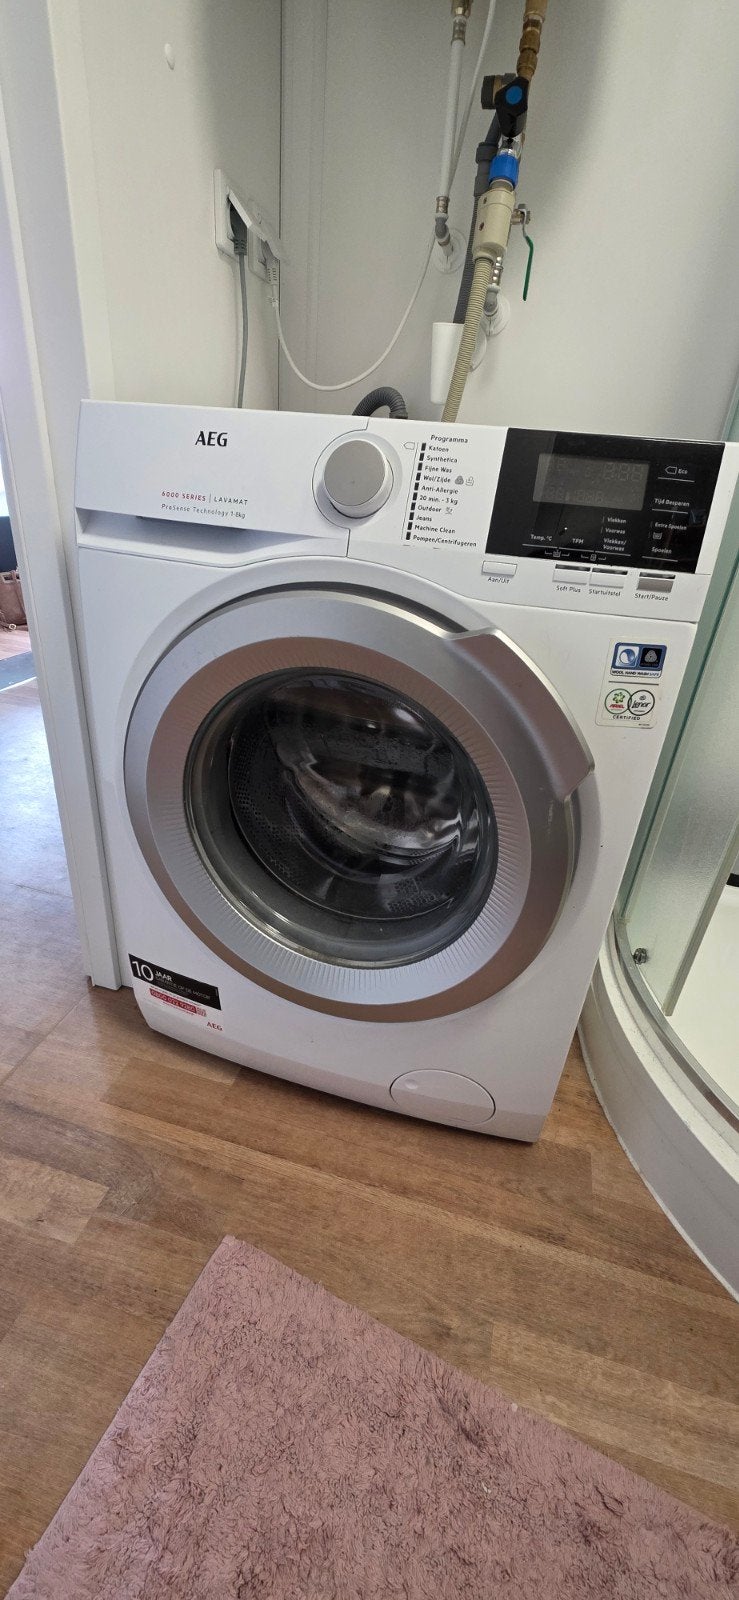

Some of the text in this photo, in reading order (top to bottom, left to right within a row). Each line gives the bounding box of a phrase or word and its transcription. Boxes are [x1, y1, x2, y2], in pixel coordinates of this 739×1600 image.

[195, 431, 228, 447] AEG
[431, 435, 468, 444] Programma
[427, 455, 457, 463] Synthetica
[425, 465, 438, 473] Fijne
[423, 475, 451, 483] Wol/Zijde
[421, 485, 458, 494] Anti-Allergie
[181, 492, 206, 501] SERIES
[214, 496, 248, 505] LAVAMAT
[666, 499, 690, 507] Besparen
[161, 503, 190, 511] ProSense
[193, 507, 228, 517] Technology
[414, 524, 438, 532] Machine
[488, 576, 510, 584] Aan/Uit
[635, 593, 669, 602] Start/Pauze
[132, 961, 154, 982] 10
[155, 971, 172, 981] JAAR
[207, 1021, 223, 1031] AEG
